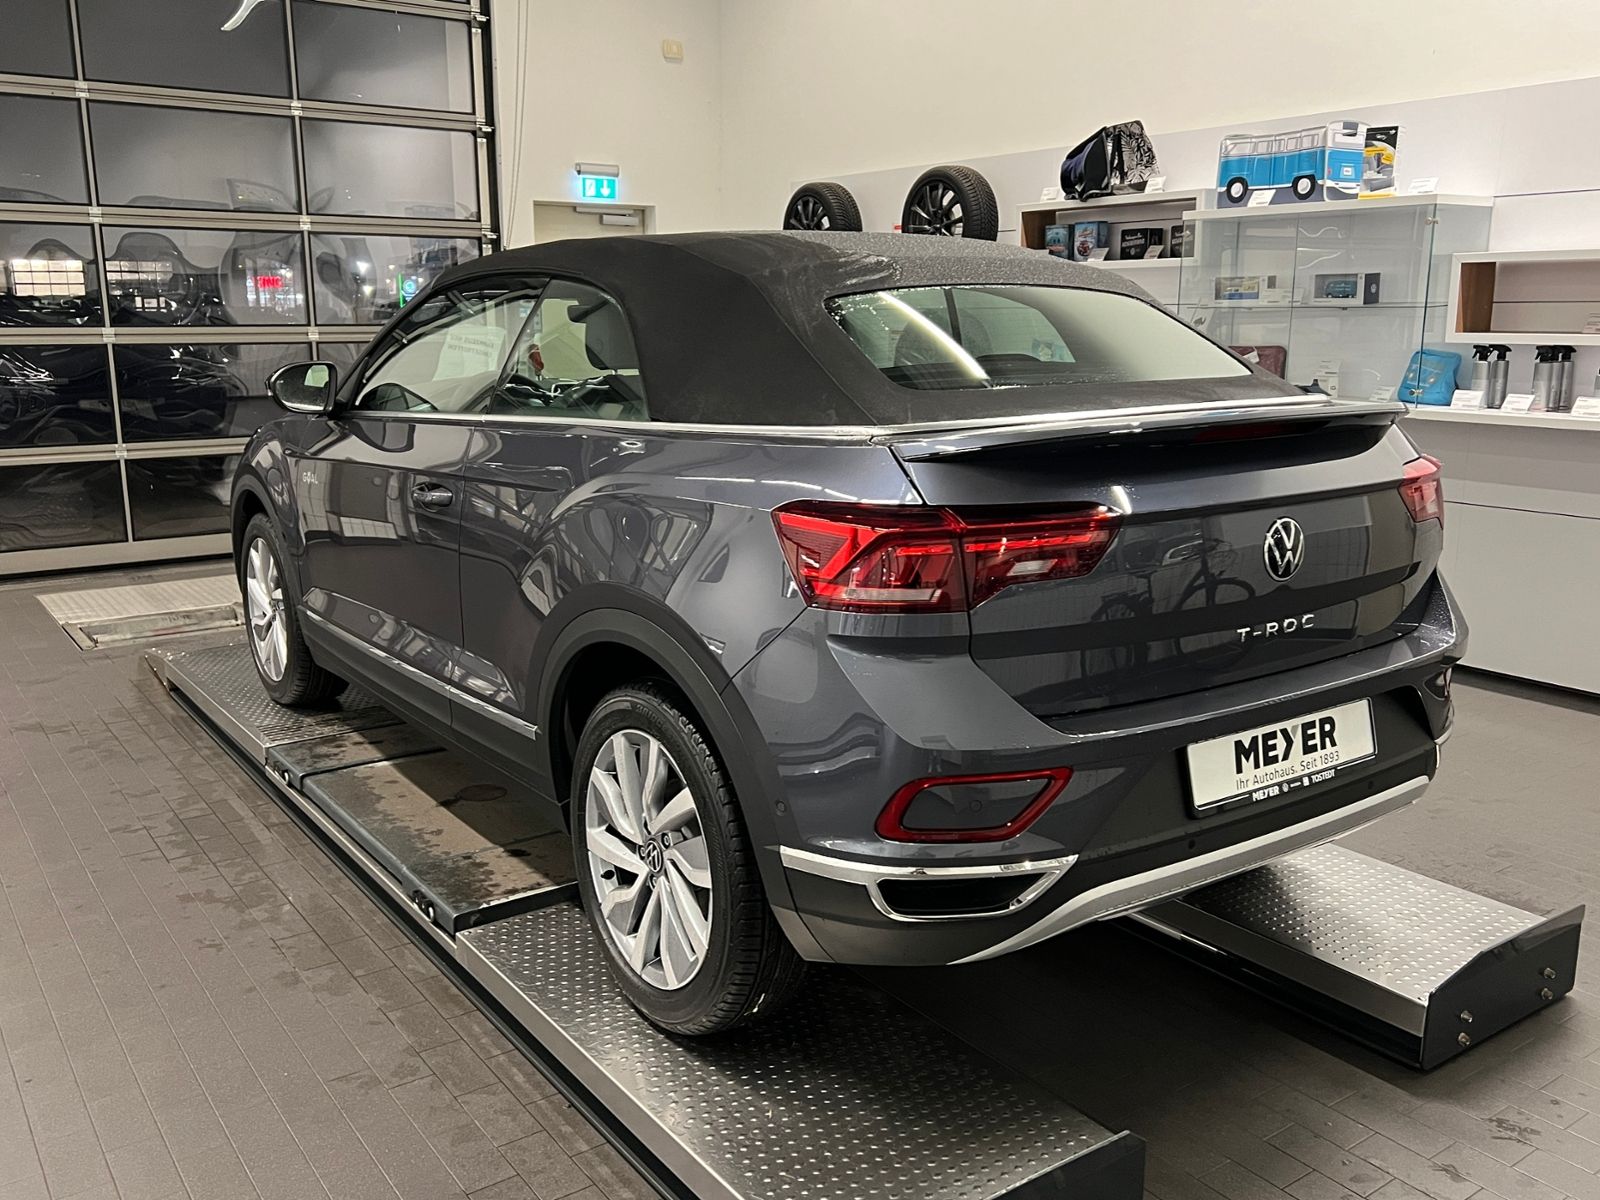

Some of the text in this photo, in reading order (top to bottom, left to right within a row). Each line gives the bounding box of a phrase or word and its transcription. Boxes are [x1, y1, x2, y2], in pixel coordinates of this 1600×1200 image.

[1236, 614, 1316, 643] T-ROC
[1234, 716, 1337, 774] MEYER
[1237, 778, 1249, 790] Ihr
[1253, 766, 1297, 785] Autohaus.
[1300, 759, 1317, 771] Seit
[1320, 751, 1339, 765] 1893
[1253, 786, 1279, 801] MEYER
[1311, 770, 1335, 783] TOSTEDT
